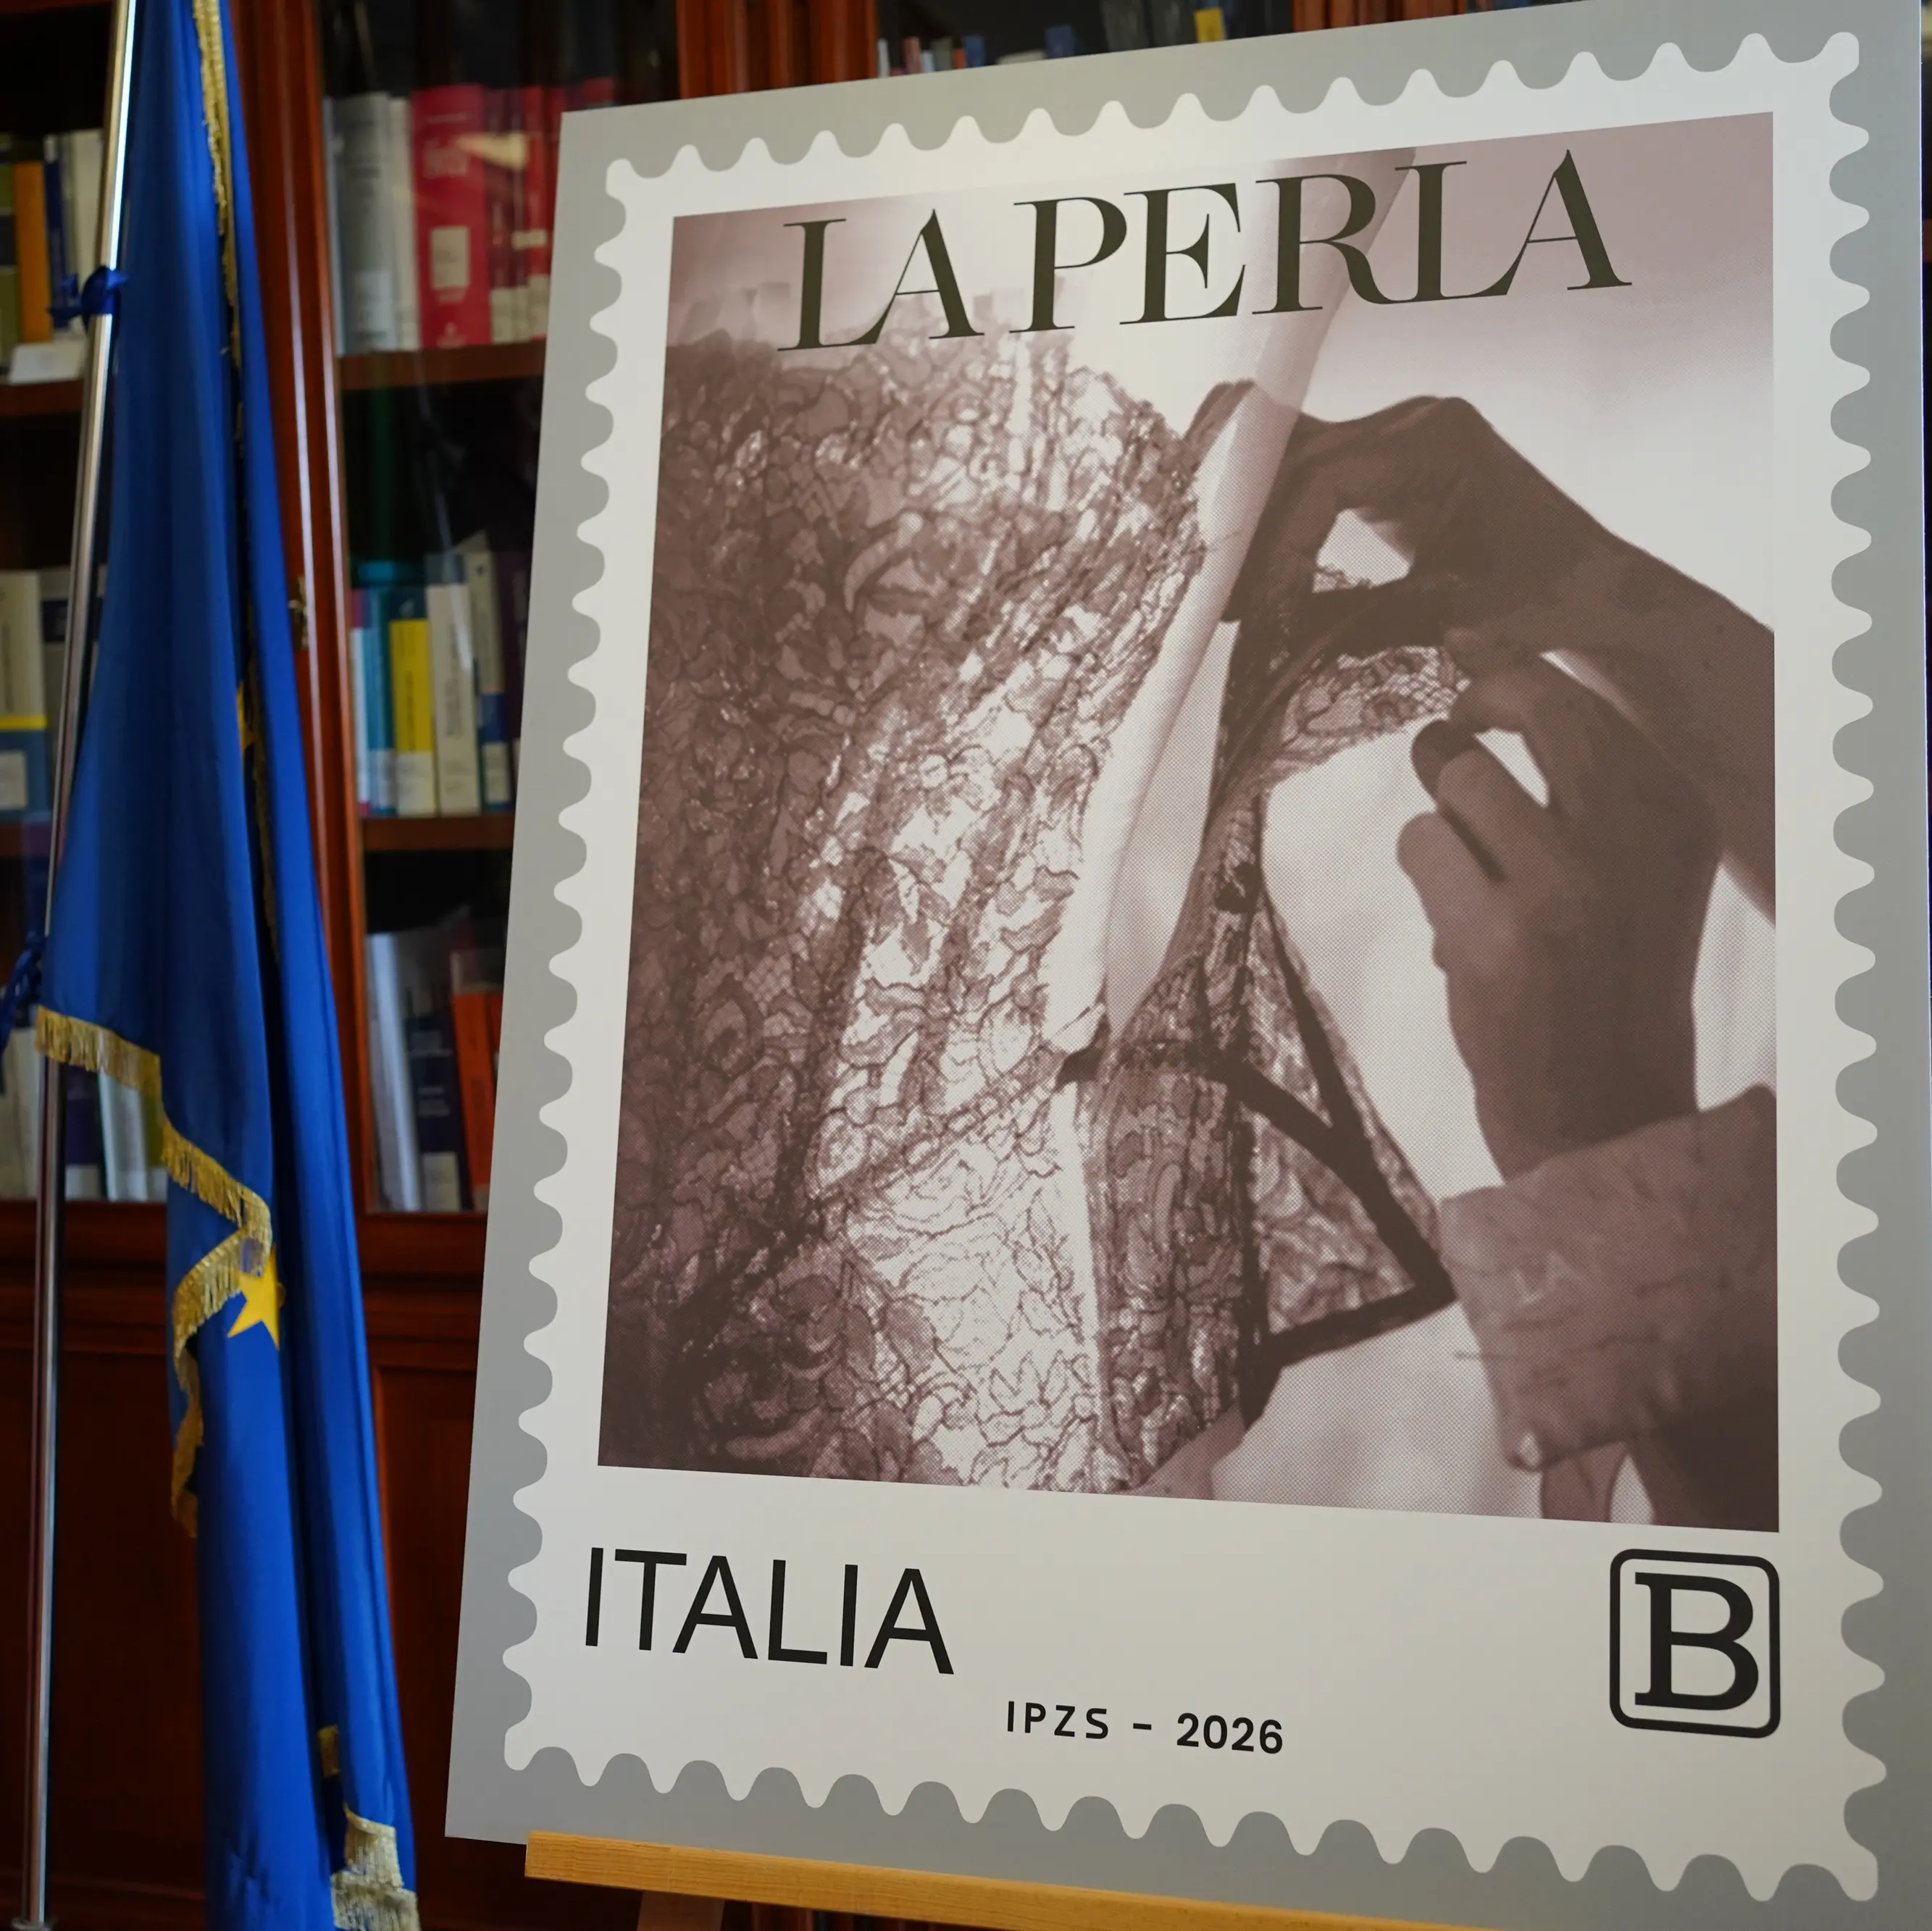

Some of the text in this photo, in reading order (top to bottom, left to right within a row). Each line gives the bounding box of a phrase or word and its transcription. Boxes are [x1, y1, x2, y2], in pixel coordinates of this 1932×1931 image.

[777, 148, 1633, 351] LA PERLA
[585, 1547, 954, 1675] ITALIA
[1634, 1572, 1759, 1711] B
[1007, 1701, 1108, 1740] IPZS
[1176, 1712, 1283, 1754] 2026
